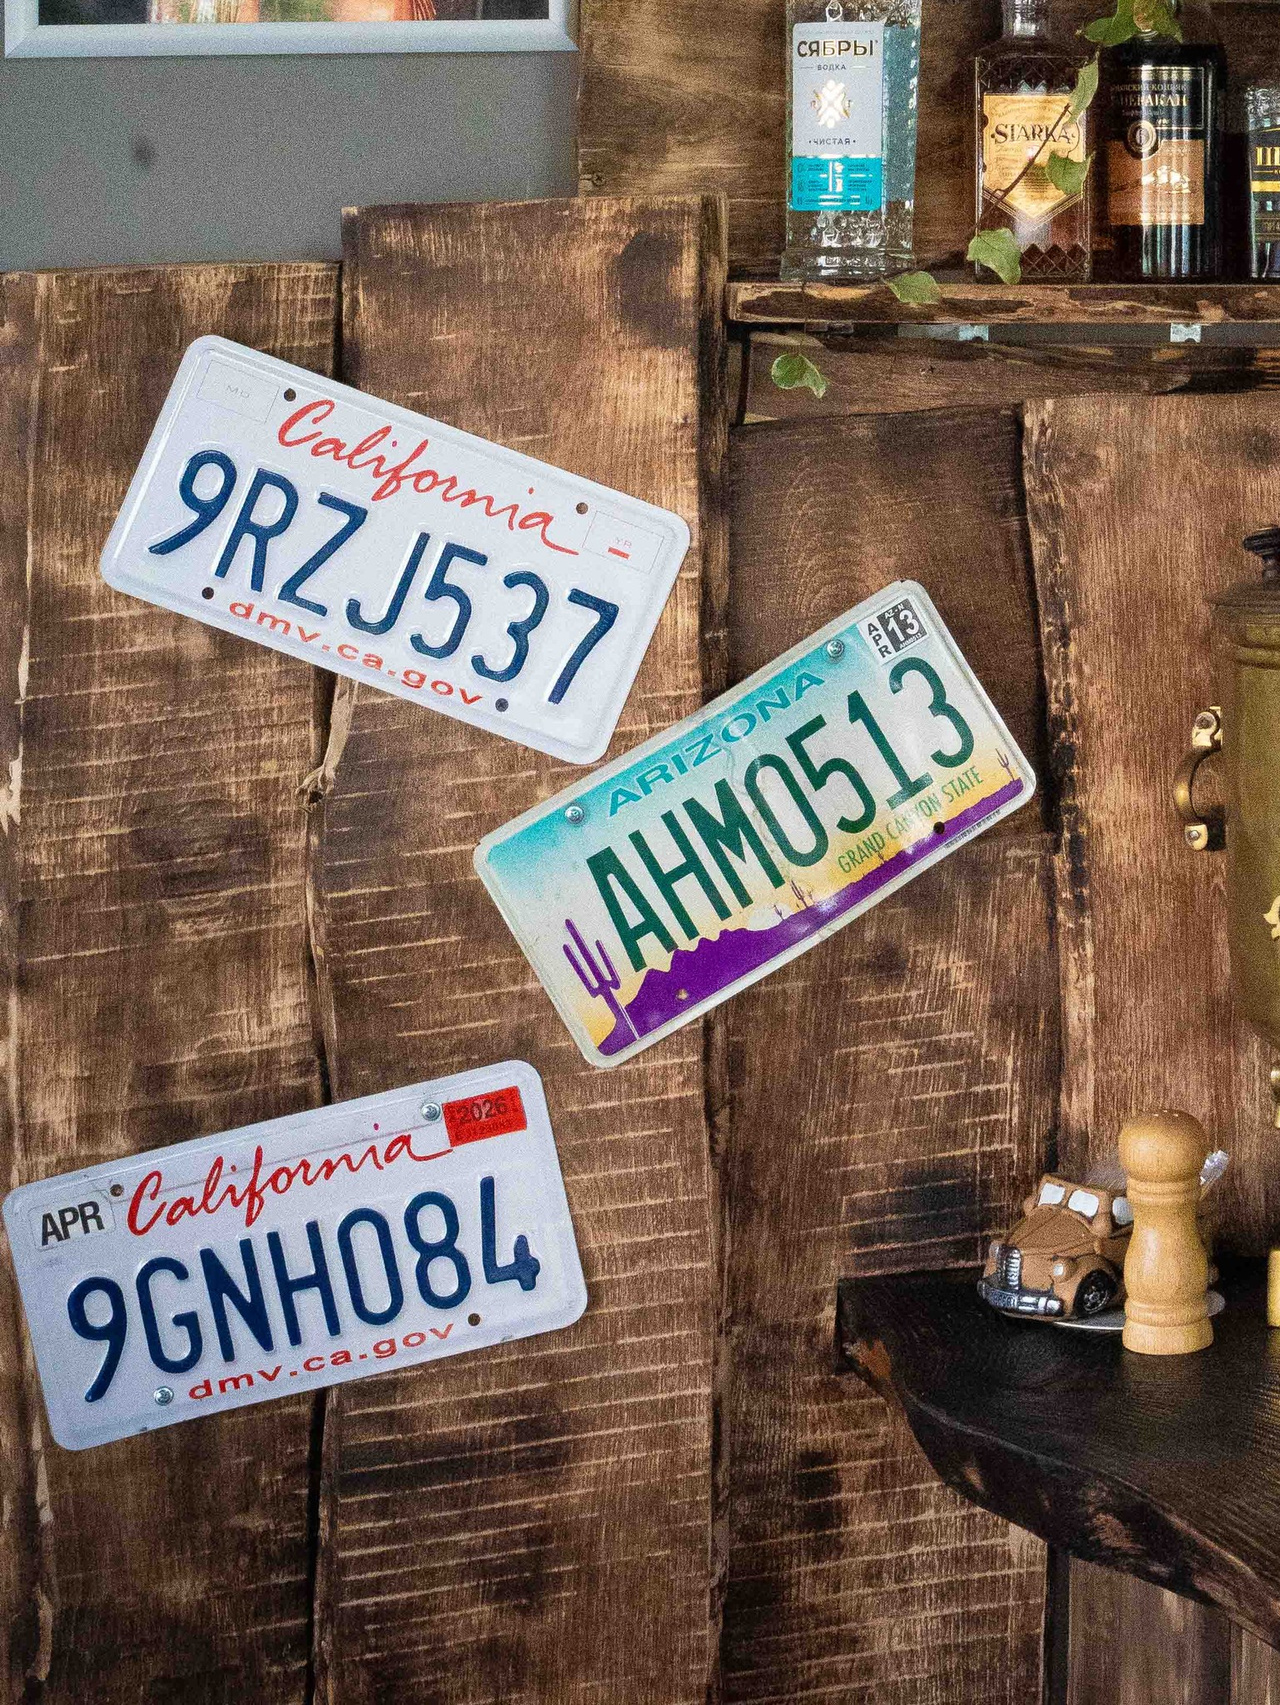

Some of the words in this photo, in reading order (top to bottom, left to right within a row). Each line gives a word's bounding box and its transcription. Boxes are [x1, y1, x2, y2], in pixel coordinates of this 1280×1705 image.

[797, 40, 875, 58] СЯБРЫ
[812, 137, 851, 146] ЧИСТАЯ
[278, 399, 580, 556] California
[147, 449, 620, 706] 9RZJ537
[887, 609, 920, 642] 13
[228, 598, 483, 707] dmv.ca.gov
[867, 622, 892, 659] APR
[607, 671, 826, 818] ARIZONA
[586, 656, 976, 973] AHM0513
[837, 831, 886, 874] GRAND
[886, 792, 942, 840] CANYON
[941, 765, 984, 803] STATE
[39, 1199, 106, 1247] APR
[127, 1121, 454, 1237] California
[66, 1174, 541, 1404] 9GNH084
[187, 1322, 455, 1402] dmv.ca.gov
